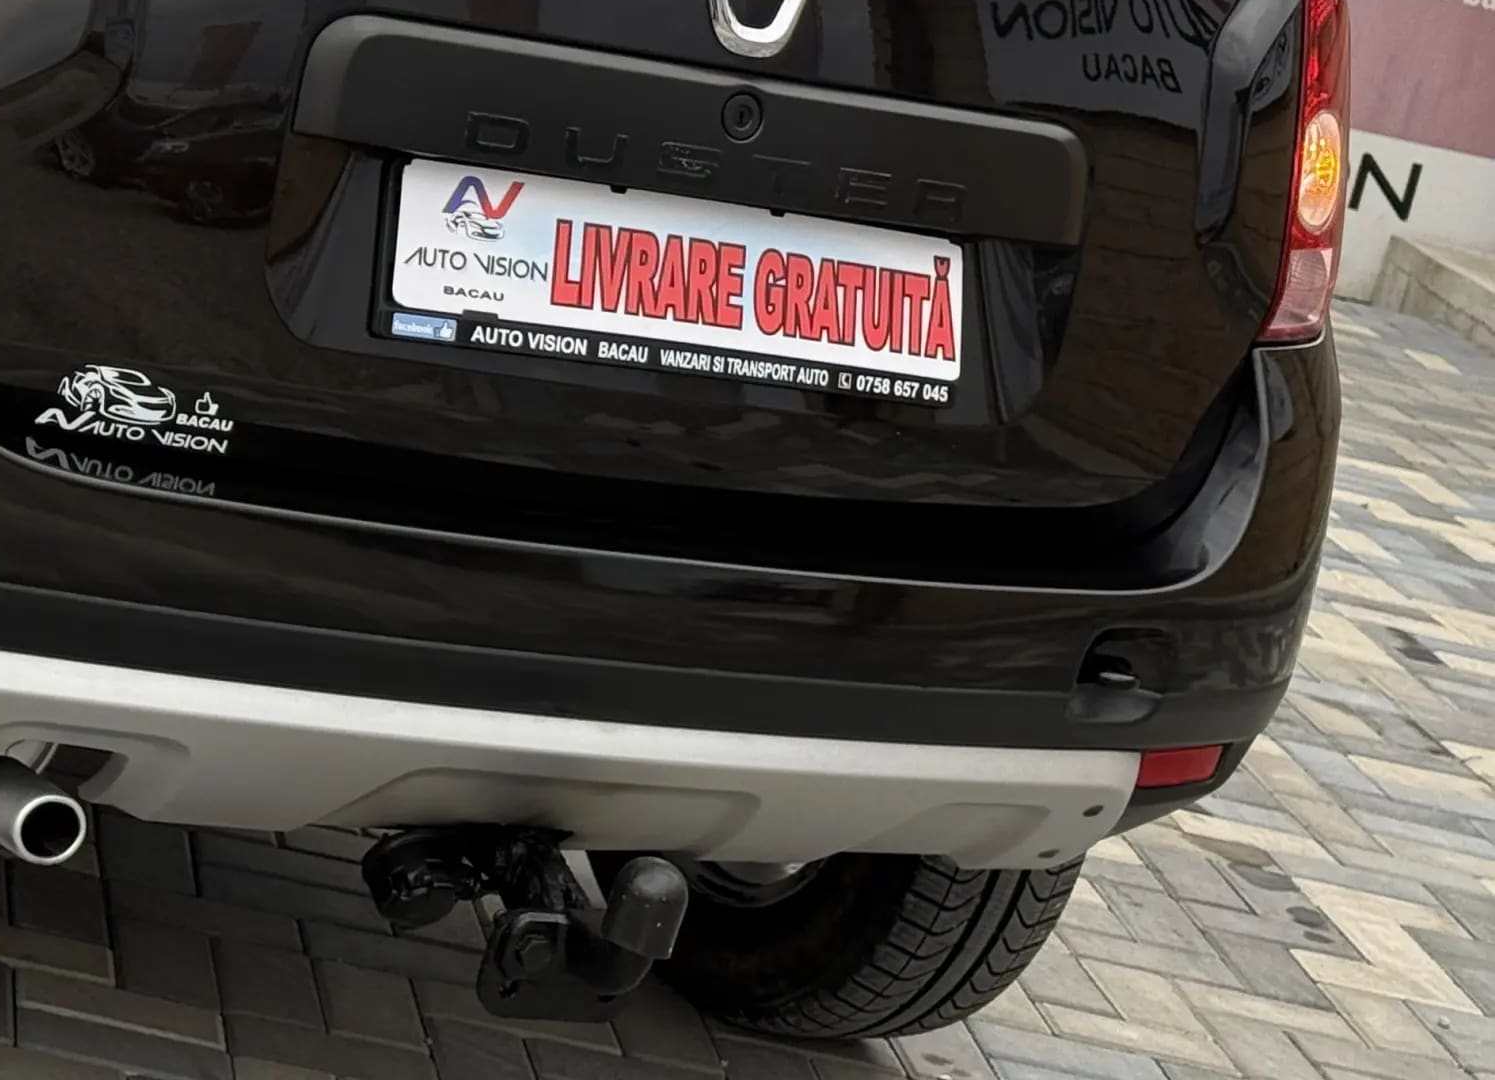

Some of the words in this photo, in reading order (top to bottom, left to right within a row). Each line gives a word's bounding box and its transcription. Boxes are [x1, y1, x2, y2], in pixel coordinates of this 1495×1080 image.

[465, 110, 968, 222] DUSTER
[404, 246, 467, 271] AUTO
[474, 252, 548, 282] VISION
[443, 286, 505, 302] BACAU
[550, 219, 747, 330] LIVRARE
[754, 248, 956, 362] GRATUITĂ
[470, 325, 523, 347] AUTO
[528, 331, 588, 356] VISION
[598, 341, 649, 364] BACAU
[660, 349, 710, 372] VANZARI
[713, 357, 725, 373] SI
[726, 357, 797, 383] TRANSPORT
[797, 368, 829, 387] AUTO
[856, 377, 890, 395] 0758
[894, 381, 919, 399] 657
[922, 385, 950, 403] 045
[79, 423, 145, 441] AUTO
[152, 429, 229, 454] VISION
[175, 413, 234, 432] BACAU
